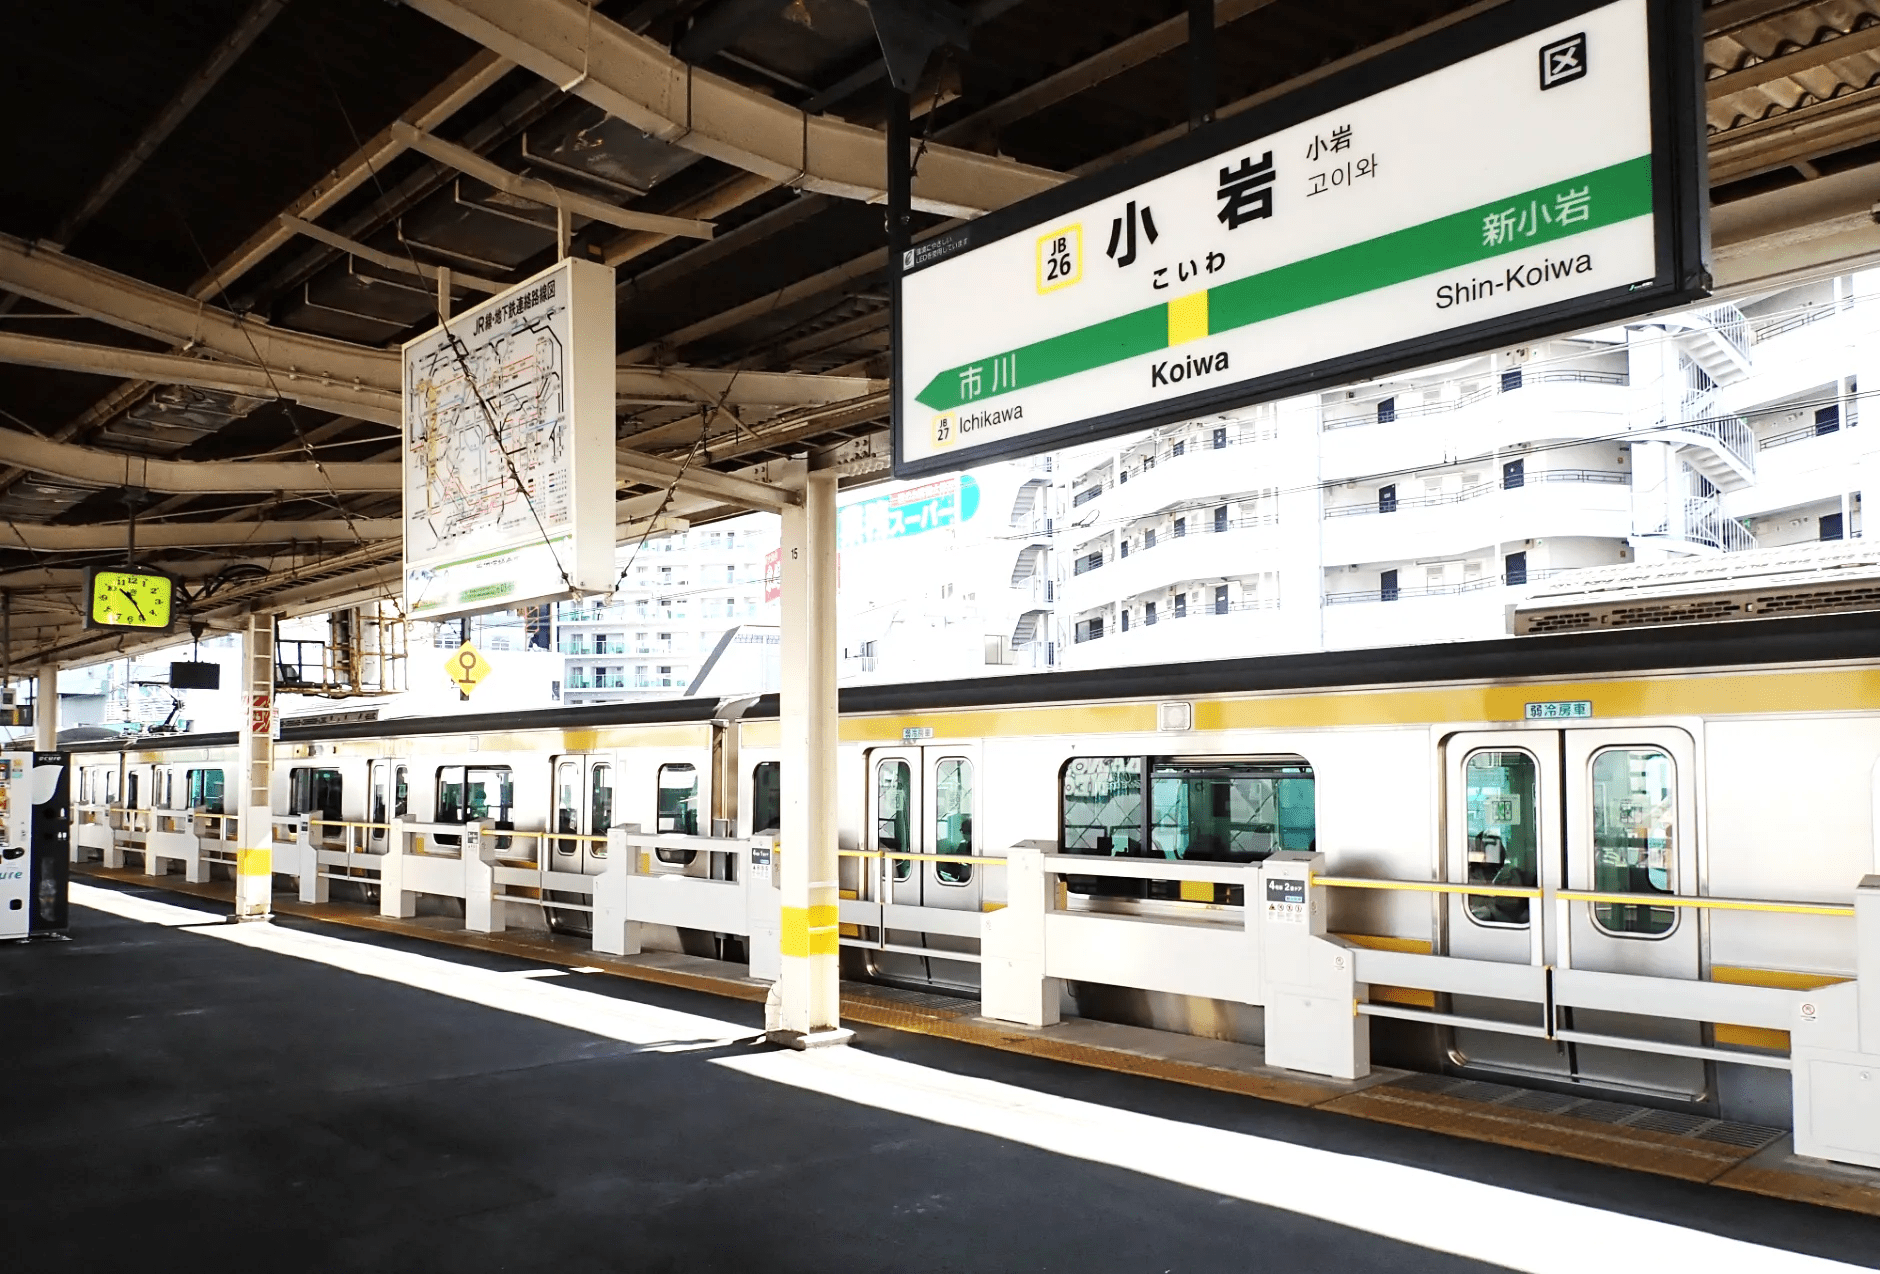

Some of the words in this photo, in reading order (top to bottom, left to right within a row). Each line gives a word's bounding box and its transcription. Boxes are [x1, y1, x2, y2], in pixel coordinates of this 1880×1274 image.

[1543, 36, 1584, 86] 区
[1305, 124, 1353, 161] 小岩
[1306, 153, 1378, 198] 고이와
[1106, 151, 1276, 268] 小岩
[1482, 186, 1591, 247] 新小岩
[916, 237, 953, 255] にやさしい
[1051, 237, 1067, 257] JB
[1047, 262, 1071, 281] 26
[1153, 251, 1226, 289] こいわ
[1436, 251, 1593, 309] Shin-Koiwa
[959, 354, 1016, 400] 市川
[1151, 351, 1229, 388] Koiwa
[937, 428, 950, 441] 27
[959, 404, 1023, 434] Ichikawa
[790, 547, 798, 560] 15
[1529, 703, 1586, 717] 弱冷房車
